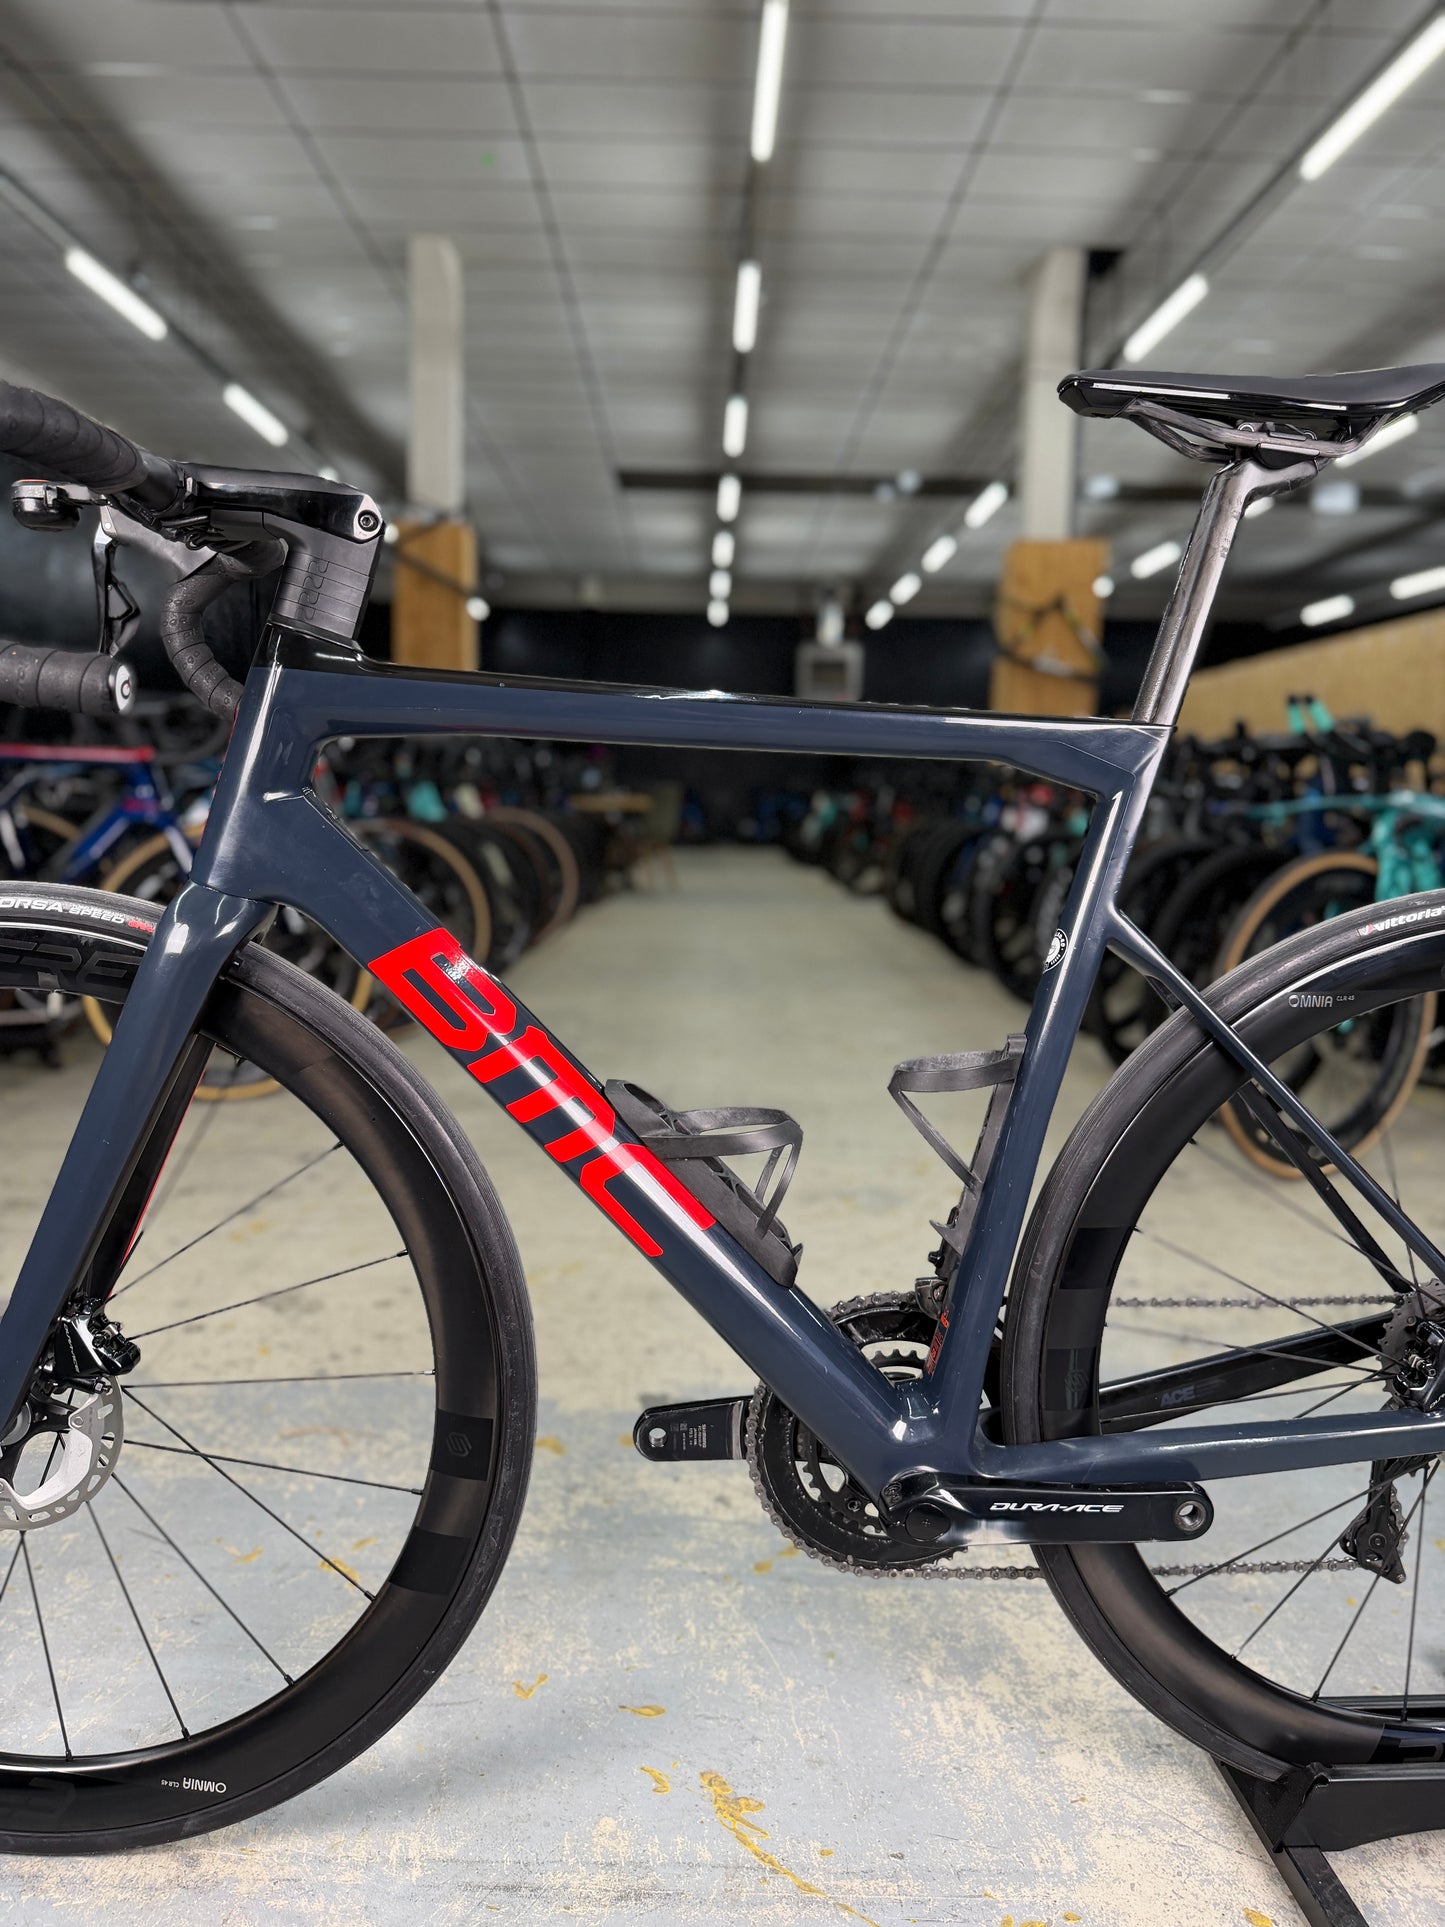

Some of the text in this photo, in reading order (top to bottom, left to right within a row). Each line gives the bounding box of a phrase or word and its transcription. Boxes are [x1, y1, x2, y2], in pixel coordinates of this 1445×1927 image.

[68, 906, 125, 924] SPEED
[1288, 994, 1333, 1008] OMNIA
[367, 927, 717, 1257] BMC
[989, 1502, 1125, 1513] DURA-ACE
[182, 1776, 227, 1794] OMNIA
